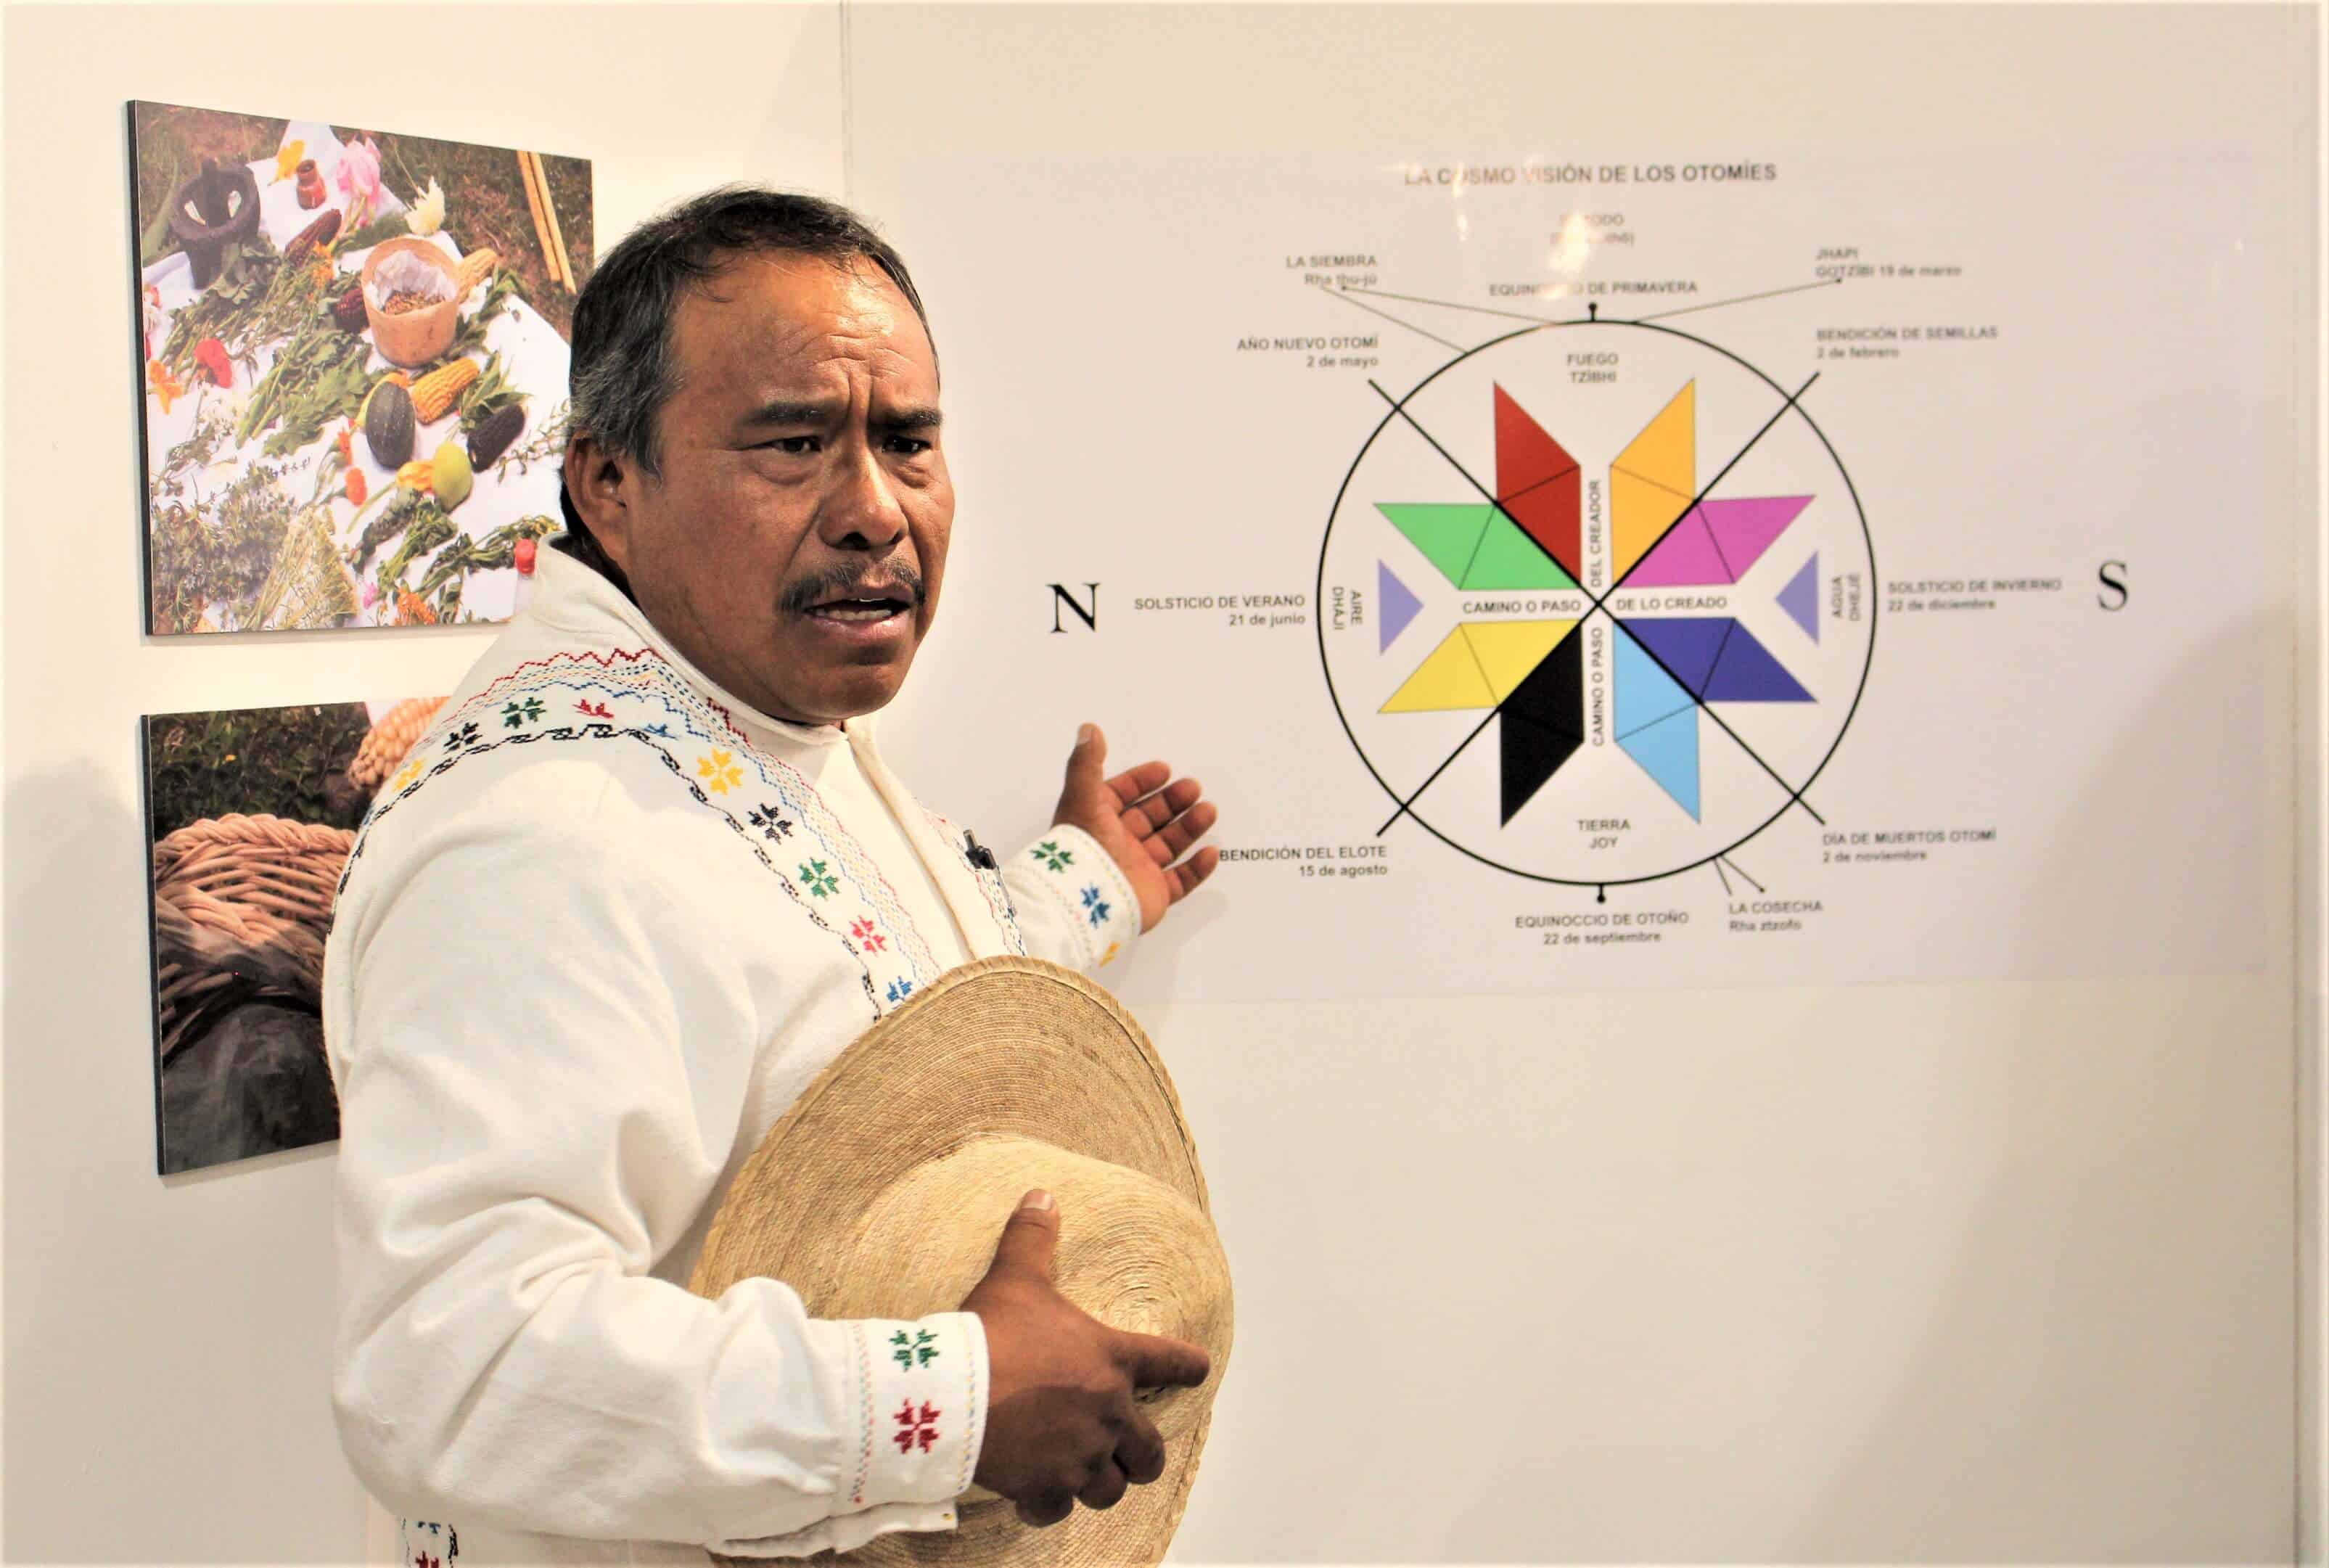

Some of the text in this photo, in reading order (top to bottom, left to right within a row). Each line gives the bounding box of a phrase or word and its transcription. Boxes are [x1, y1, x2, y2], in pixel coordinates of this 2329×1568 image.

[1599, 165, 1625, 183] DE
[1634, 165, 1676, 182] LOS
[1682, 162, 1776, 181] OTOMÍES
[1286, 255, 1377, 268] LA SIEMBRA
[1898, 266, 1915, 276] de
[1919, 267, 1962, 276] marzo
[1588, 282, 1606, 295] DE
[1612, 282, 1697, 293] PRIMAVERA
[1817, 327, 1997, 342] BENDICIÓN DE SEMILLAS
[1237, 337, 1269, 350] AÑO
[1273, 337, 1326, 350] NUEVO
[1567, 353, 1619, 366] FUEGO
[1817, 346, 1899, 360] 2 de febrero
[1306, 354, 1379, 369] 2 de mayo
[1588, 480, 1602, 588] DEL CREADOR
[1888, 579, 2061, 594] SOLSTICIO DE INVIERNO
[2099, 562, 2127, 609] S
[1135, 595, 1305, 609] SOLSTICIO DE VERANO
[1616, 596, 1728, 611] DE LO CREADO
[1831, 575, 1843, 618] AGUA
[1048, 583, 1099, 633] N
[1351, 591, 1363, 624] AIRE
[1463, 599, 1581, 614] CAMINO O PASO
[1888, 598, 1997, 612] 22 de diciembre
[1229, 613, 1306, 628] 21 de junio
[1590, 627, 1604, 747] CAMINO O PASO
[1577, 818, 1631, 832] TIERRA
[1589, 837, 1618, 849] JOY
[1850, 833, 1869, 845] DE
[1875, 831, 1946, 844] MUERTOS
[1220, 845, 1387, 861] BENDICIÓN DEL ELOTE
[1823, 850, 1927, 863] 2 de noviembre
[1300, 865, 1387, 879] 15 de agosto
[1729, 900, 1823, 914] LA COSECHA
[1515, 910, 1689, 929] EQUINOCCIO DE OTOÑO
[1544, 932, 1661, 945] 22 de septiembre
